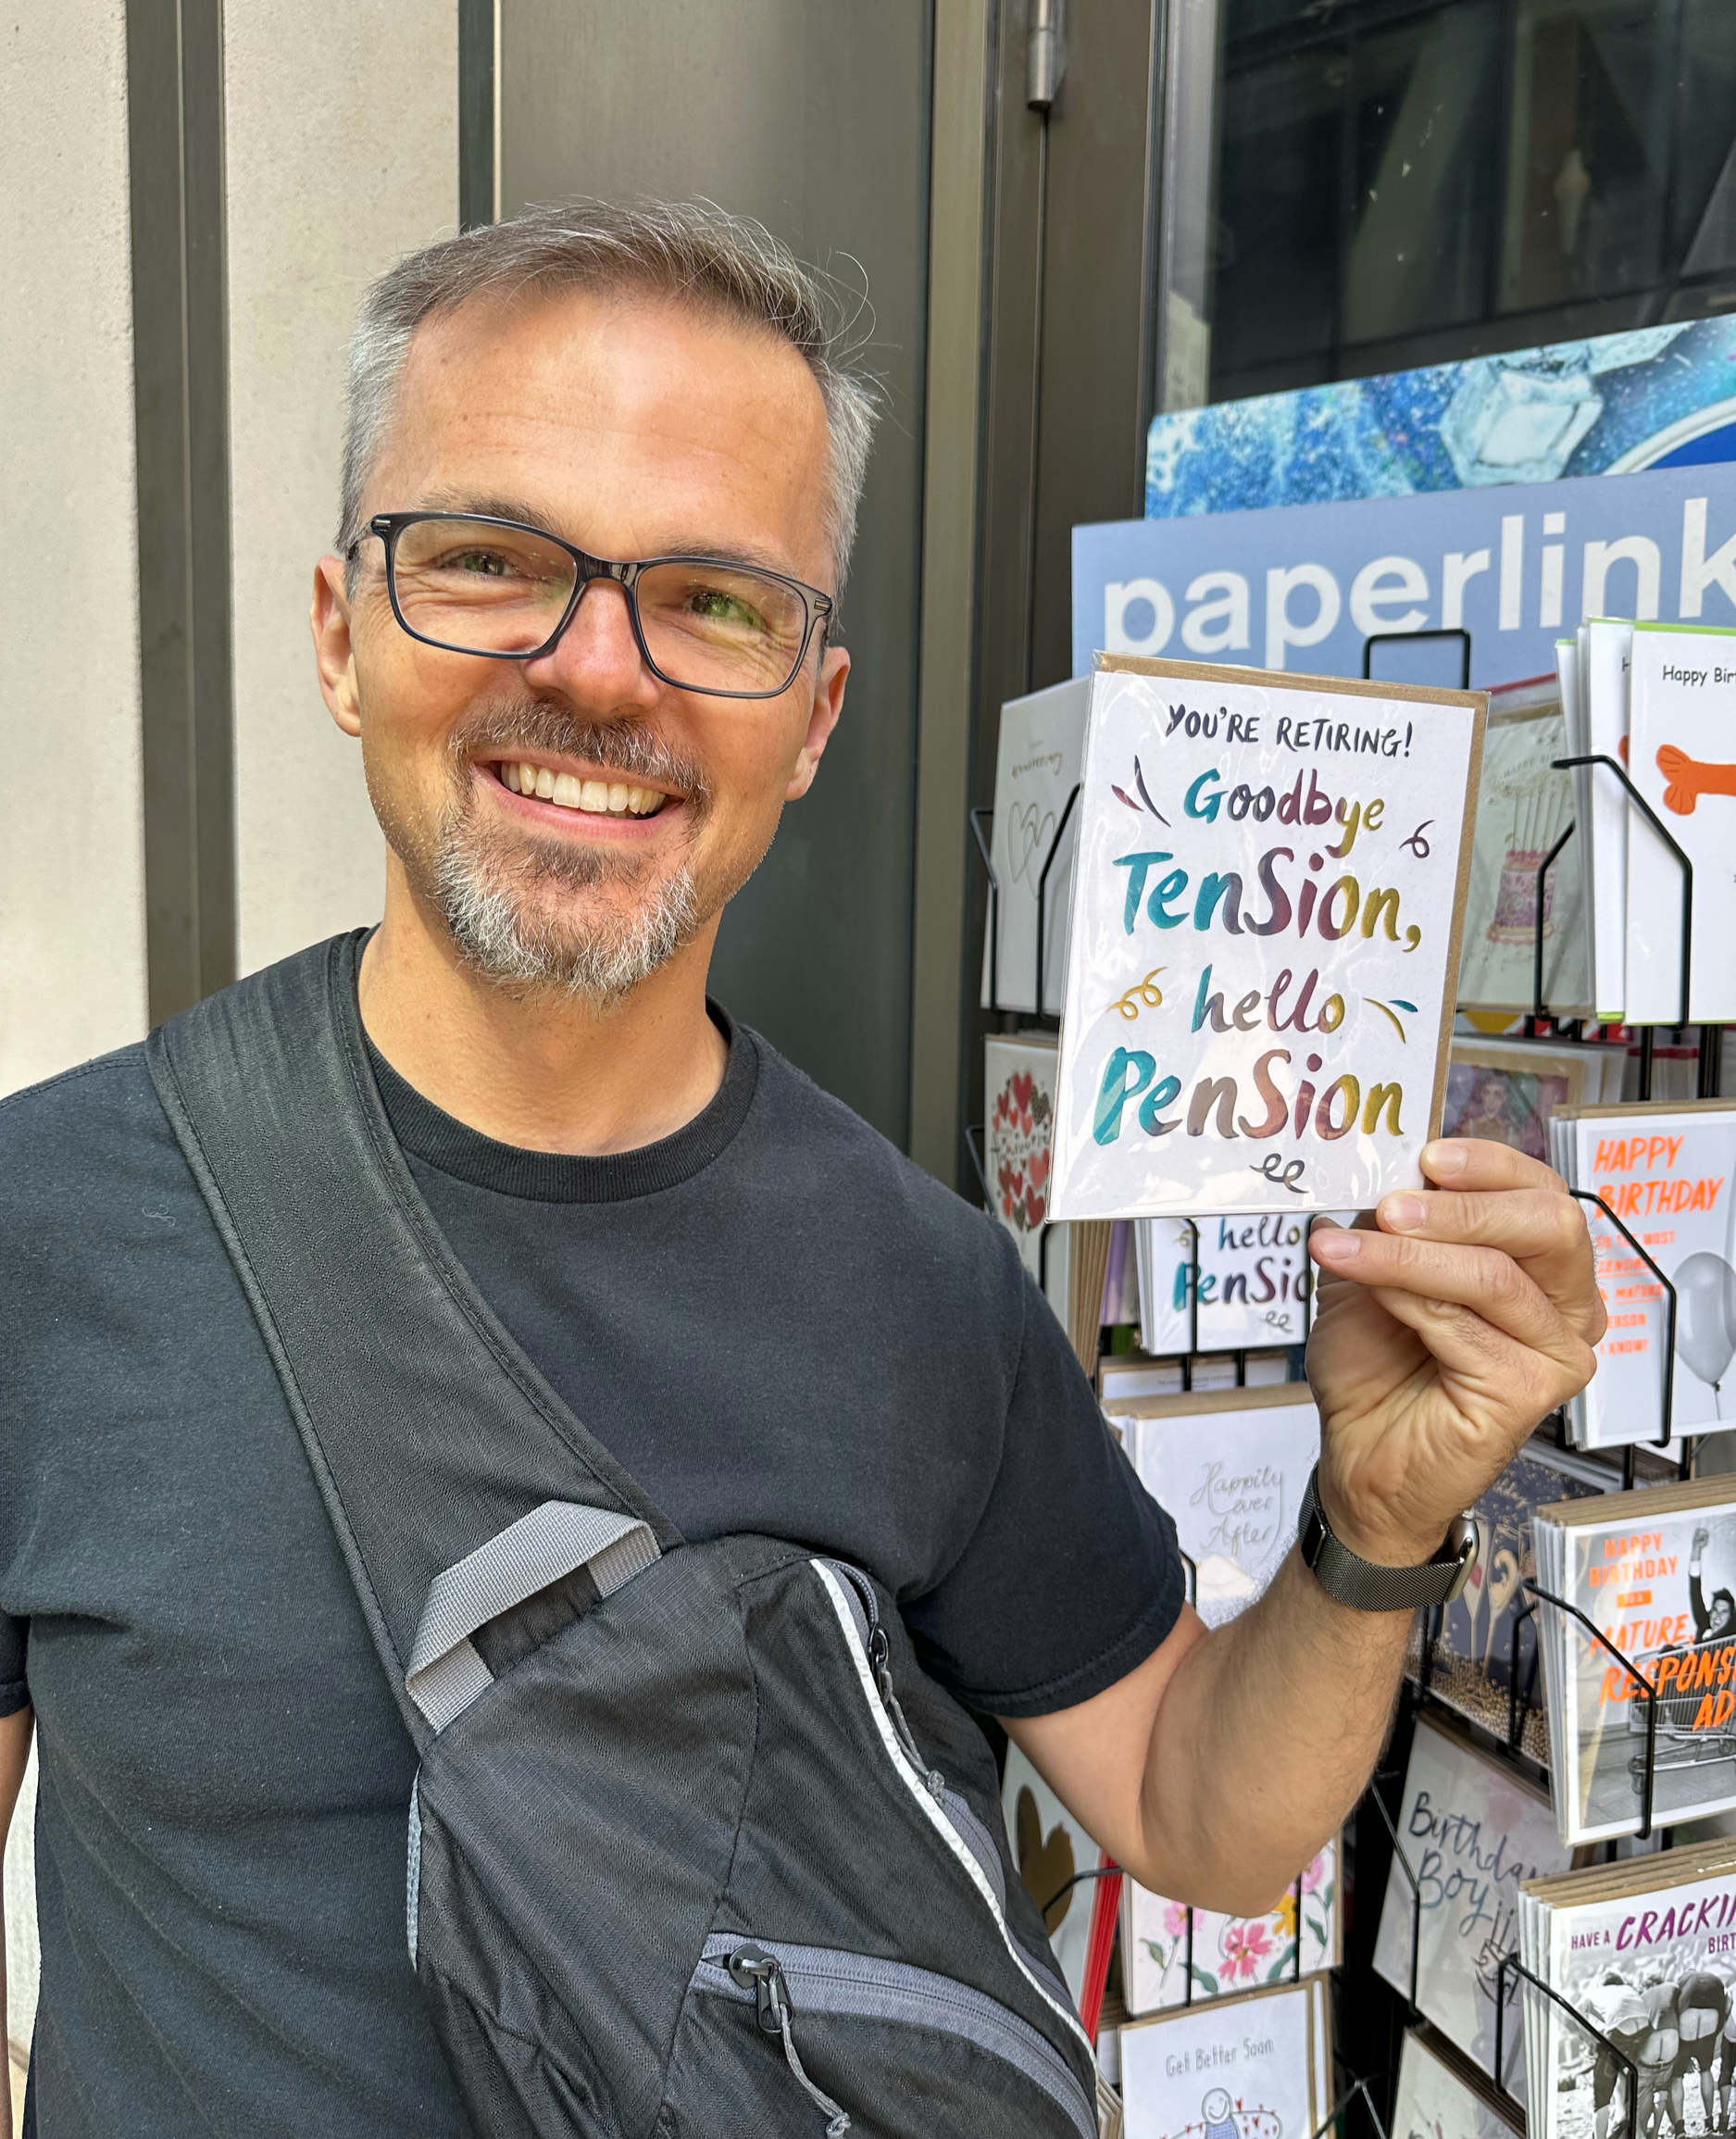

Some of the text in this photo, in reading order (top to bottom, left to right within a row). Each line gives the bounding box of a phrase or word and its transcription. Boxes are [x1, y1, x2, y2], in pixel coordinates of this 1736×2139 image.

[1105, 497, 1736, 669] paperlink
[1663, 664, 1736, 687] Happy Bir
[1166, 704, 1413, 757] YOU'RE RETIRING!
[1183, 768, 1385, 858] Goodbye
[1191, 964, 1346, 1033] hello
[1593, 1134, 1684, 1173] HAPPY
[1594, 1176, 1725, 1219] BIRTHDAY
[1218, 1215, 1301, 1251] hello
[1643, 1230, 1676, 1245] MOST
[1607, 1313, 1646, 1329] ERSON
[1608, 1339, 1648, 1355] KNOW!
[1200, 1515, 1273, 1557] After
[1605, 1532, 1663, 1559] HAPPY
[1589, 1556, 1679, 1587] BIRTHDAY
[1599, 1645, 1736, 1707] RESPONS
[1408, 1791, 1538, 1882] Birthda
[1418, 1847, 1492, 1937] Boy
[1571, 1931, 1600, 1950] HAVE
[1604, 1930, 1610, 1945] A
[1166, 2052, 1190, 2077] Get
[1195, 2044, 1237, 2071] Better
